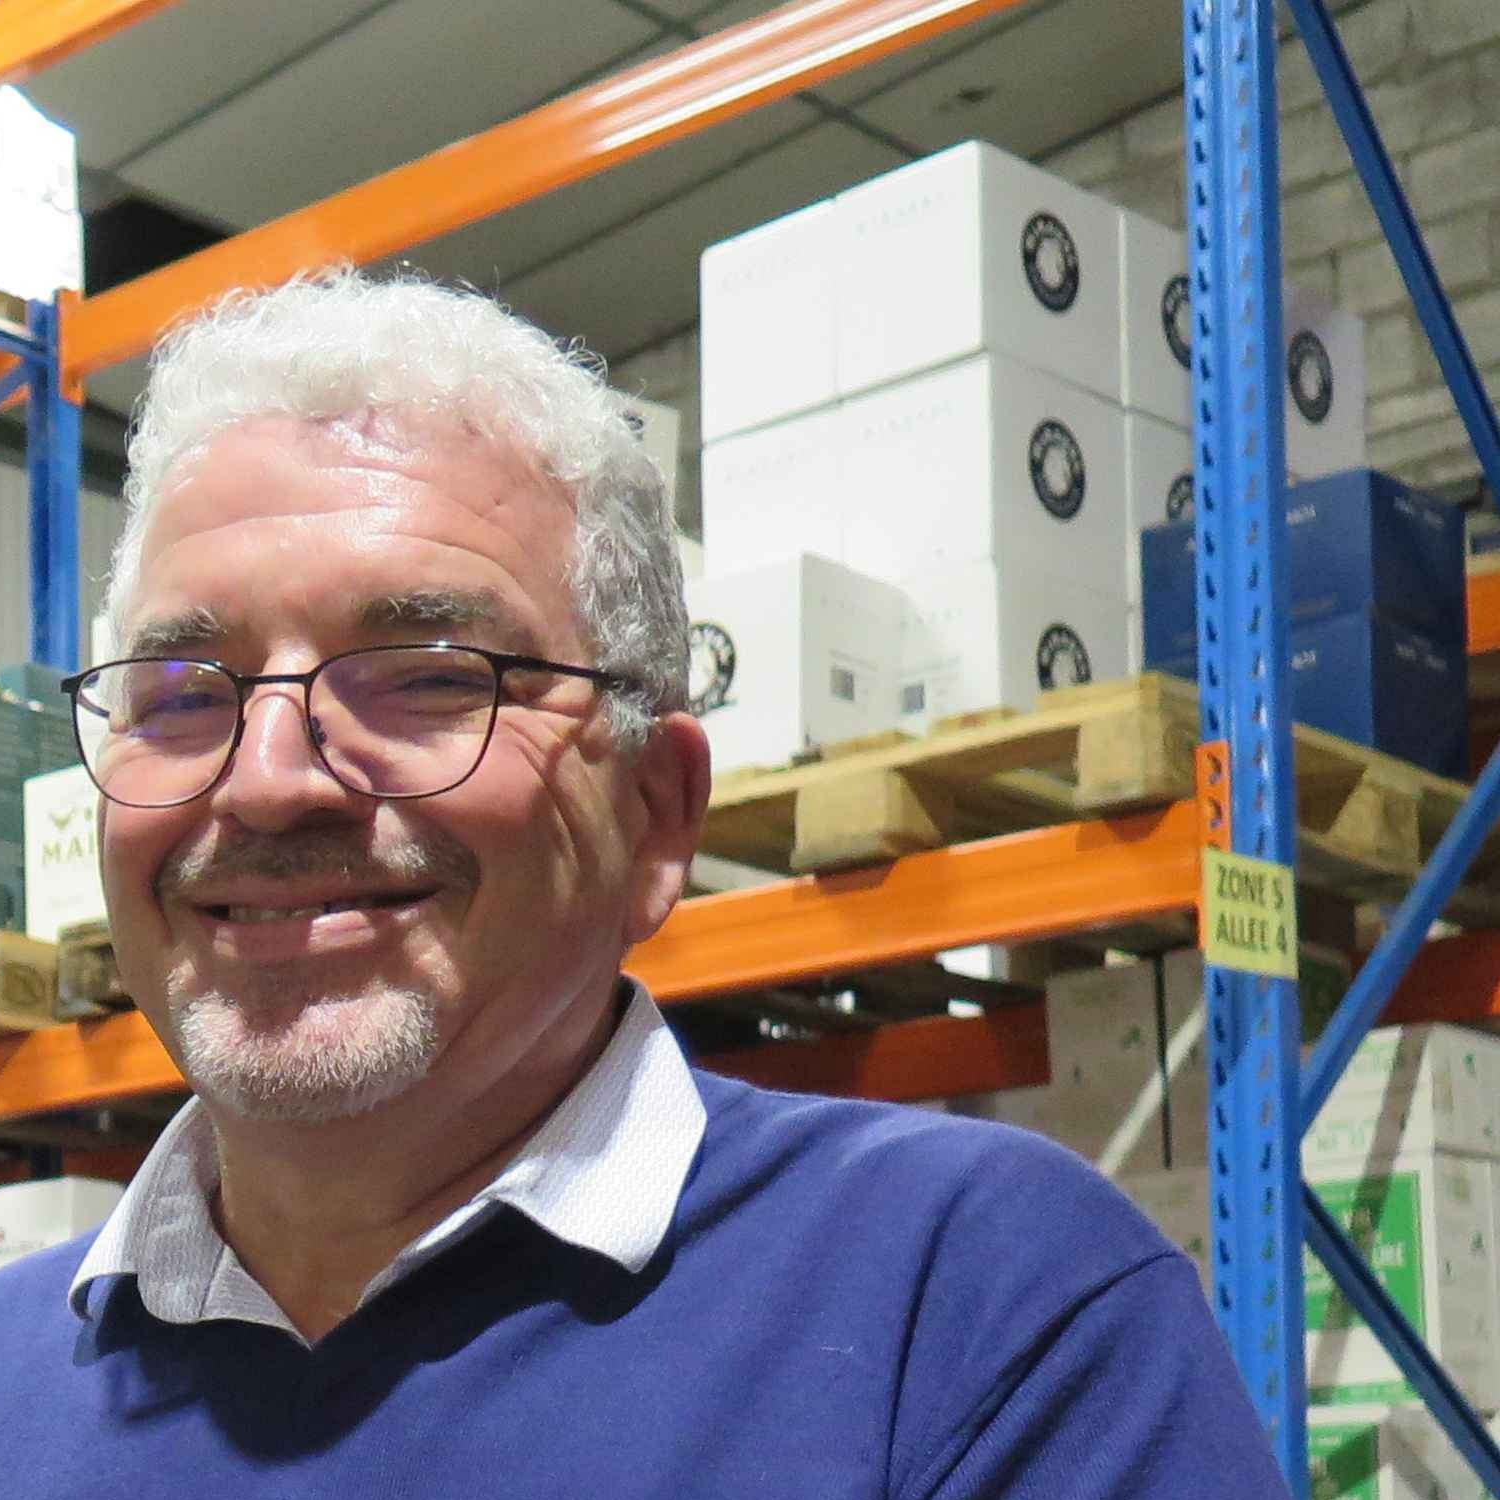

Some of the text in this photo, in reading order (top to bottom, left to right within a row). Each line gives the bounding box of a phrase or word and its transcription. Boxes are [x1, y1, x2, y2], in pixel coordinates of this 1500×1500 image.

[1218, 864, 1284, 910] ZONE 5
[1216, 913, 1288, 955] ALLEE 4
